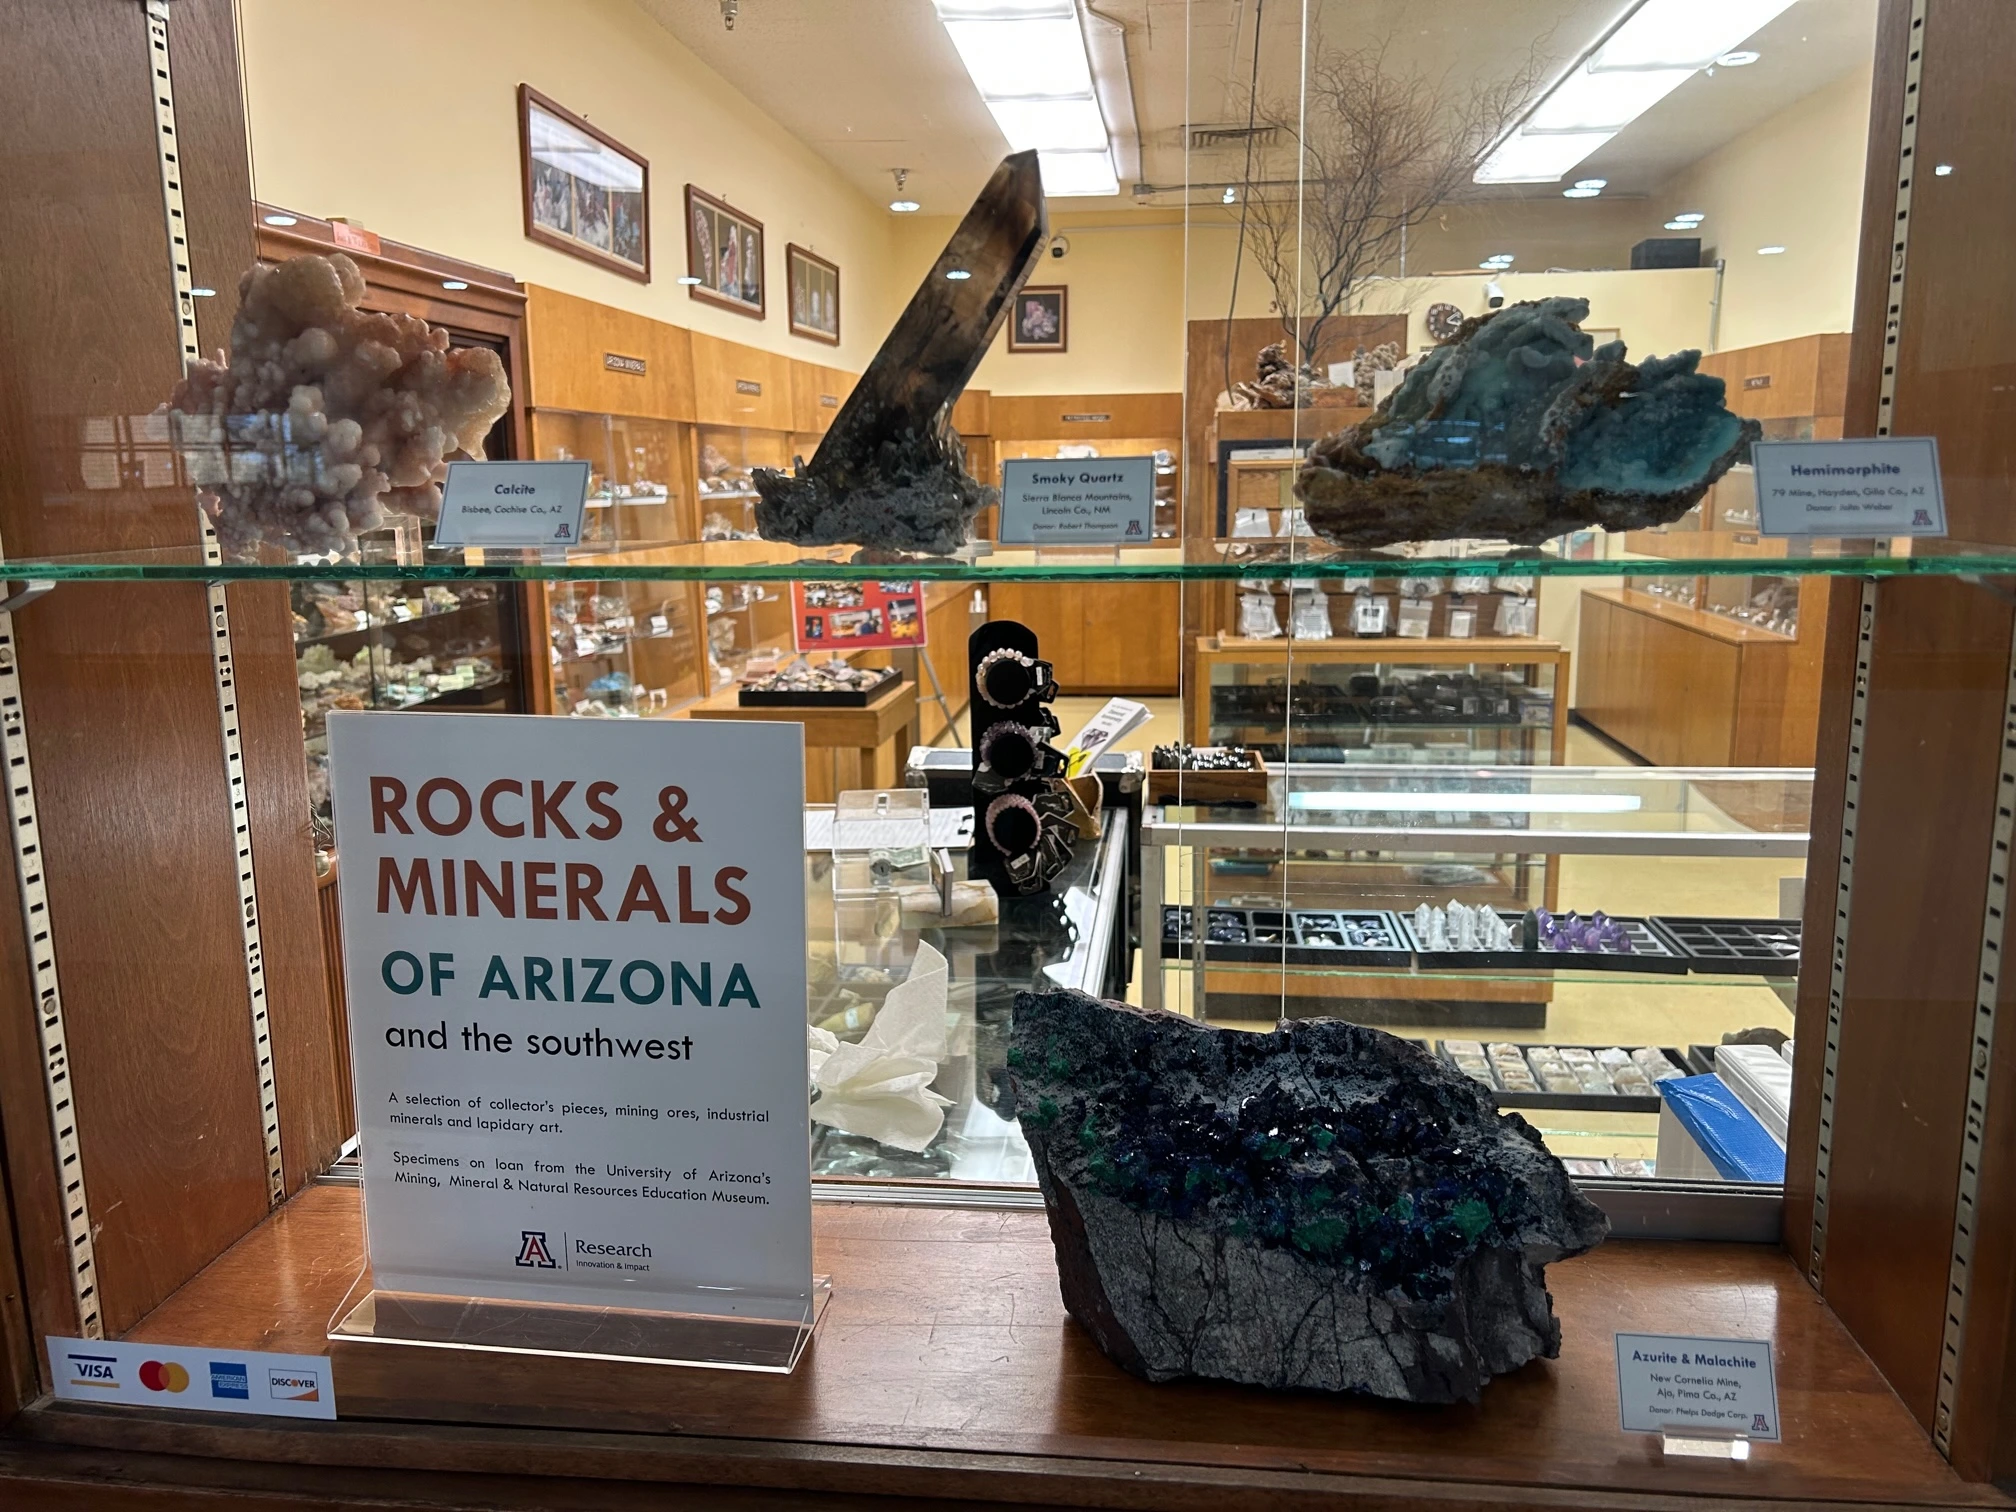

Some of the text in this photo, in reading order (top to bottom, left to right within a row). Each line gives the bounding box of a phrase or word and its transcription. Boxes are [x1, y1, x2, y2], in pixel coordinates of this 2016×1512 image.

[1791, 463, 1900, 477] Hemimorphite
[1032, 472, 1124, 486] Smoky Quartz
[494, 484, 536, 495] Calcite
[1772, 488, 1785, 497] 79
[1911, 487, 1925, 495] AZ
[1022, 493, 1132, 502] Sierra Blanca Mountains,
[461, 505, 492, 514] Bisbee,
[494, 505, 527, 514] Cochise
[550, 505, 563, 513] AZ
[1042, 506, 1071, 515] Lincoln
[1094, 506, 1111, 514] NM
[1058, 522, 1082, 530] Robert
[1084, 522, 1118, 531] Thompson
[369, 775, 704, 843] ROCKS &
[376, 856, 752, 925] MINERALS
[381, 950, 761, 1009] OF ARIZONA
[385, 1020, 693, 1061] and the southwest
[388, 1092, 769, 1122] A selection of collector's pieces, mining ores, industrial
[390, 1112, 563, 1134] minerals and lapidary art.
[393, 1151, 771, 1184] Specimens on loan from the University of Arizona's
[394, 1171, 770, 1205] Mining, Mineral & Natural Resources Education Museum.
[575, 1239, 653, 1258] Research
[576, 1259, 615, 1269] Innovation
[624, 1263, 650, 1272] Impact
[1632, 1350, 1757, 1369] Azurite & Malachite
[74, 1362, 114, 1379] VISA
[211, 1373, 245, 1382] AMERICAN
[1650, 1374, 1742, 1389] New Cornelia Mine,
[1657, 1388, 1737, 1402] Ajo, Pima Co., AZ
[1676, 1407, 1699, 1417] Phelps
[1701, 1408, 1725, 1419] Dodge
[1727, 1410, 1748, 1420] Corp.
